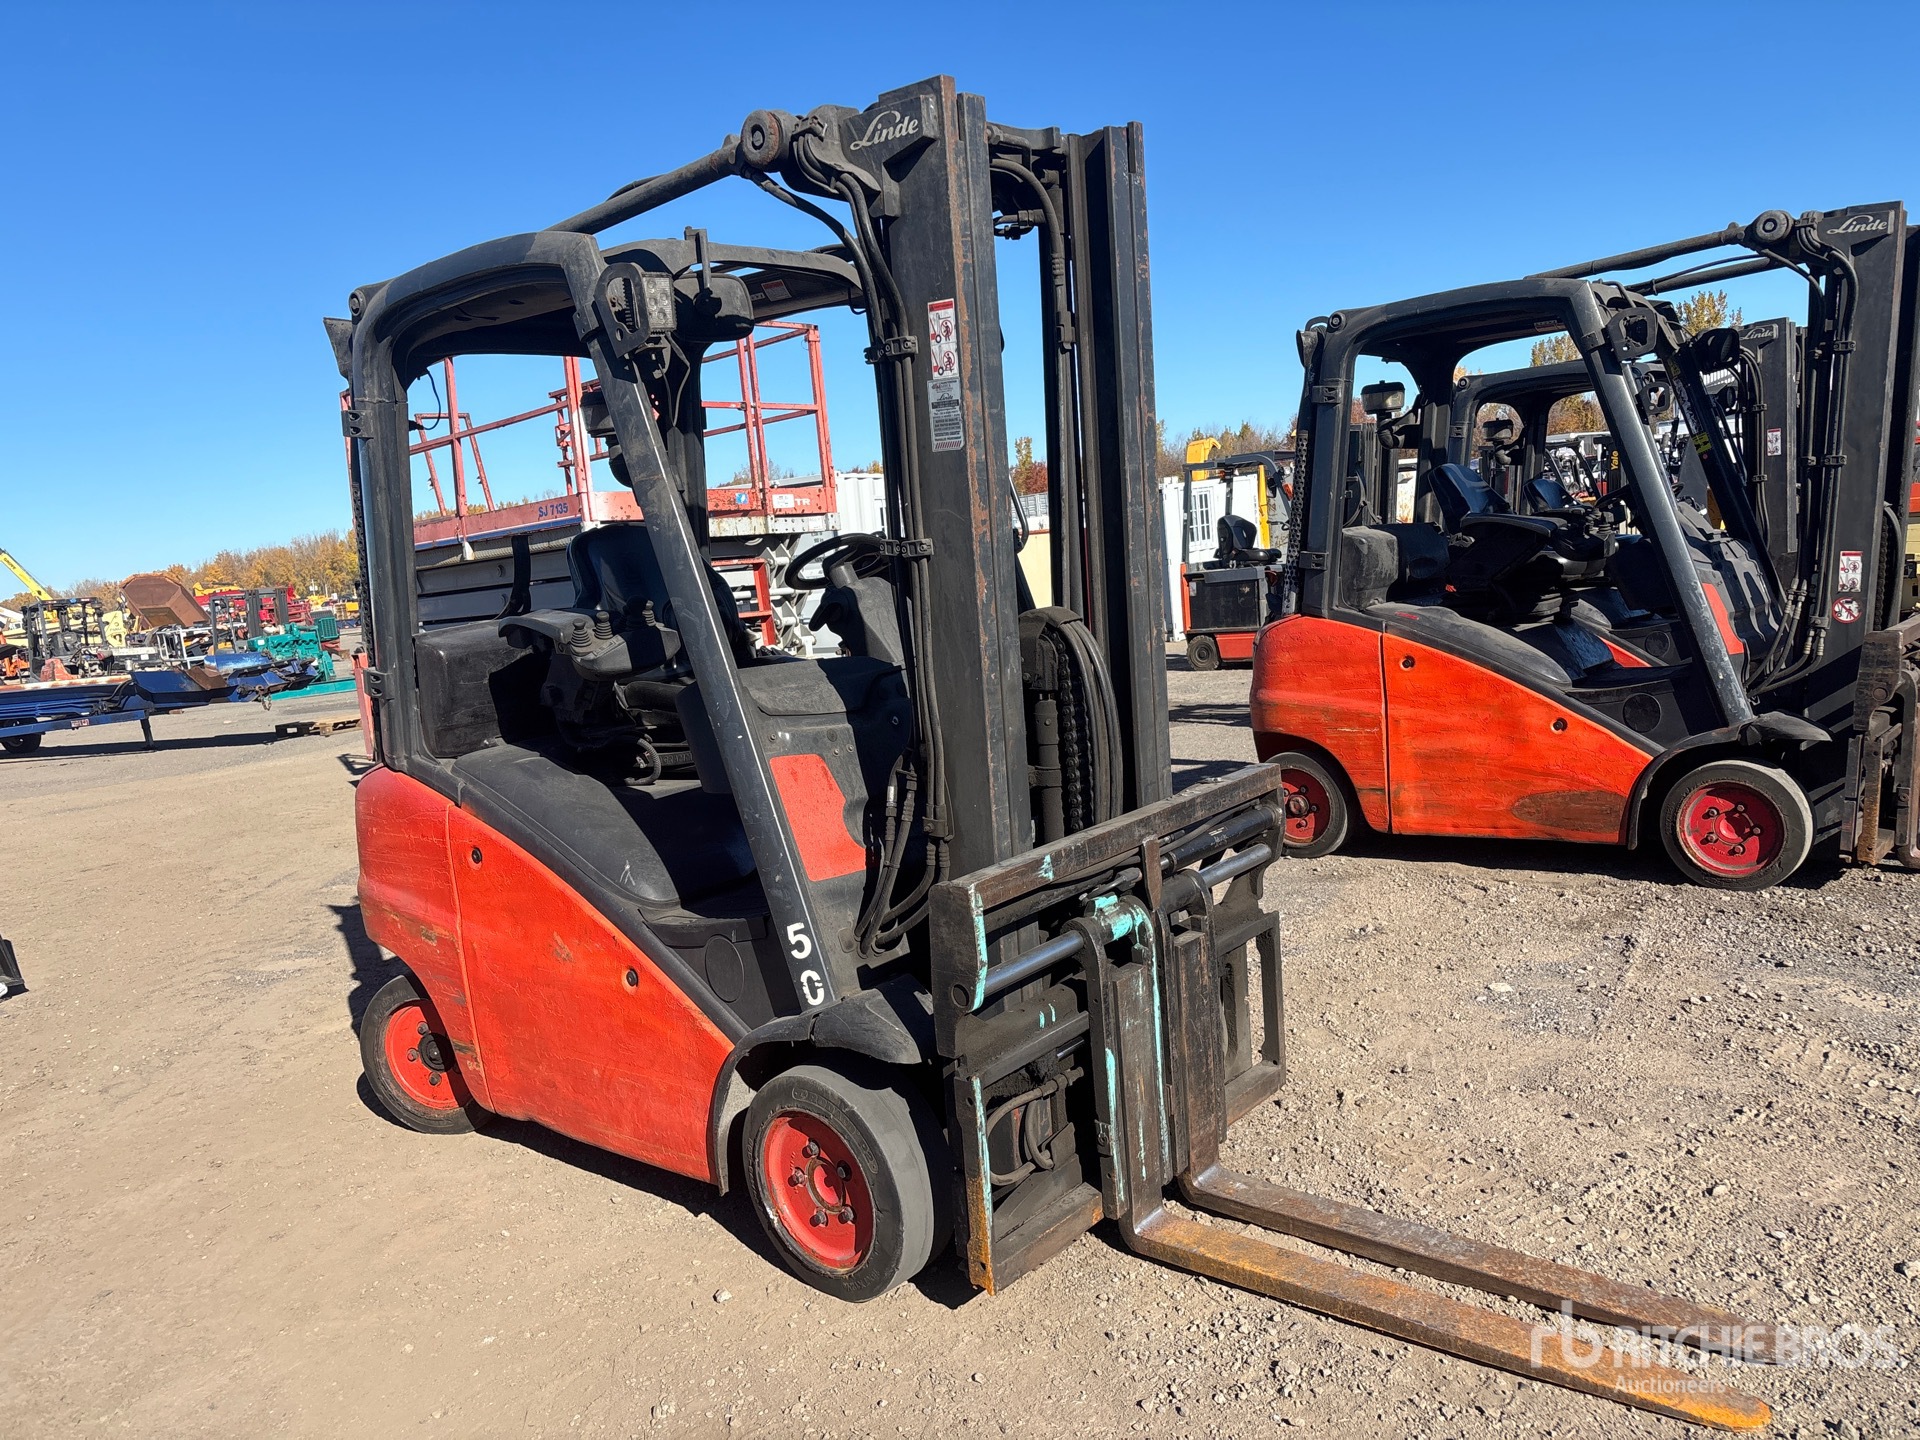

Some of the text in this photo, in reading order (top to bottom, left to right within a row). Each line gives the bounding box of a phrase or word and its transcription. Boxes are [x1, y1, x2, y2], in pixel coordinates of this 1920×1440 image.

[849, 110, 919, 151] Linde
[1827, 214, 1887, 234] Linde
[1740, 327, 1774, 341] Linde
[538, 503, 569, 518] SJ 7135
